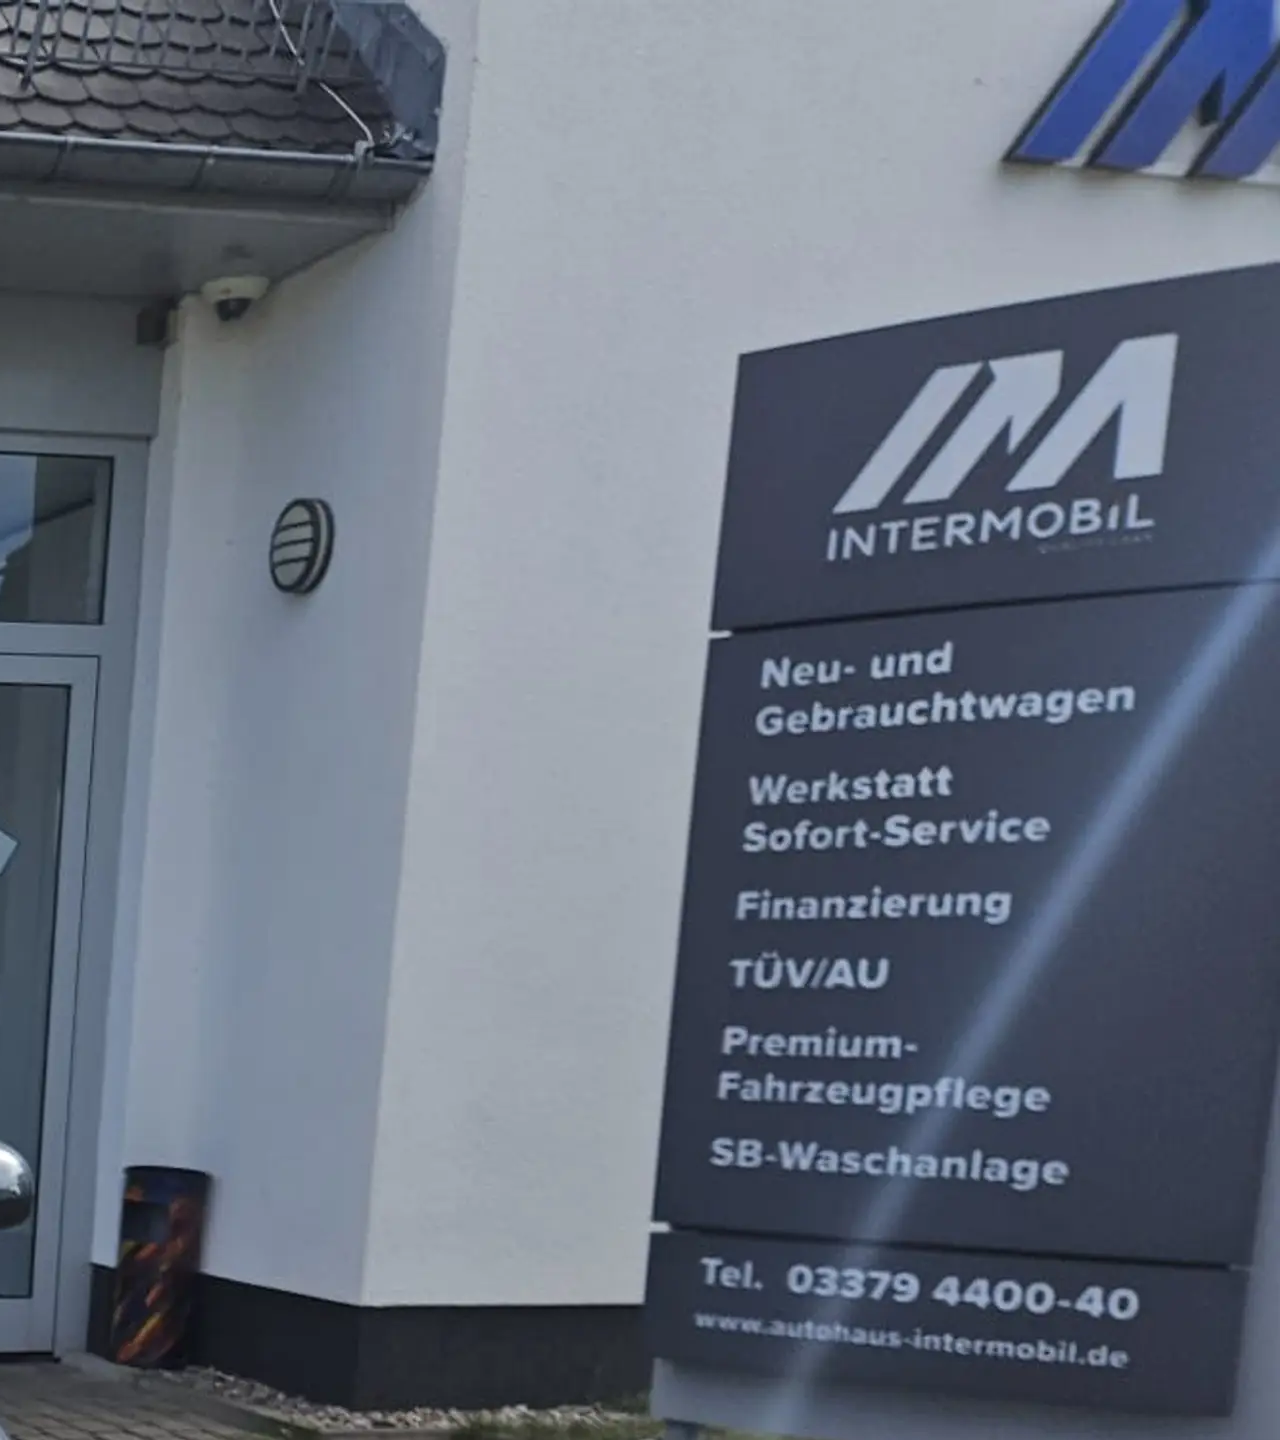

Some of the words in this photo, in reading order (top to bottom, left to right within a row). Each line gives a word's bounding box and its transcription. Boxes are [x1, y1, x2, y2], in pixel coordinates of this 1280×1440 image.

[761, 658, 856, 689] Neu-
[870, 641, 954, 679] und
[755, 685, 1135, 736] Gebrauchtwagen
[749, 766, 953, 805] Werkstatt
[742, 810, 1051, 852] Sofort-Service
[736, 886, 1012, 925] Finanzierung
[730, 951, 889, 989] TÜV/AU
[722, 1026, 918, 1059] Premium-
[718, 1071, 1051, 1118] Fahrzeugpflege
[710, 1138, 1070, 1191] SB-Waschanlage
[700, 1257, 763, 1290] Tel.
[786, 1264, 920, 1302] 03379
[931, 1275, 1139, 1320] 4400-40
[694, 1311, 1130, 1369] www.autohaus-intermobil.de
